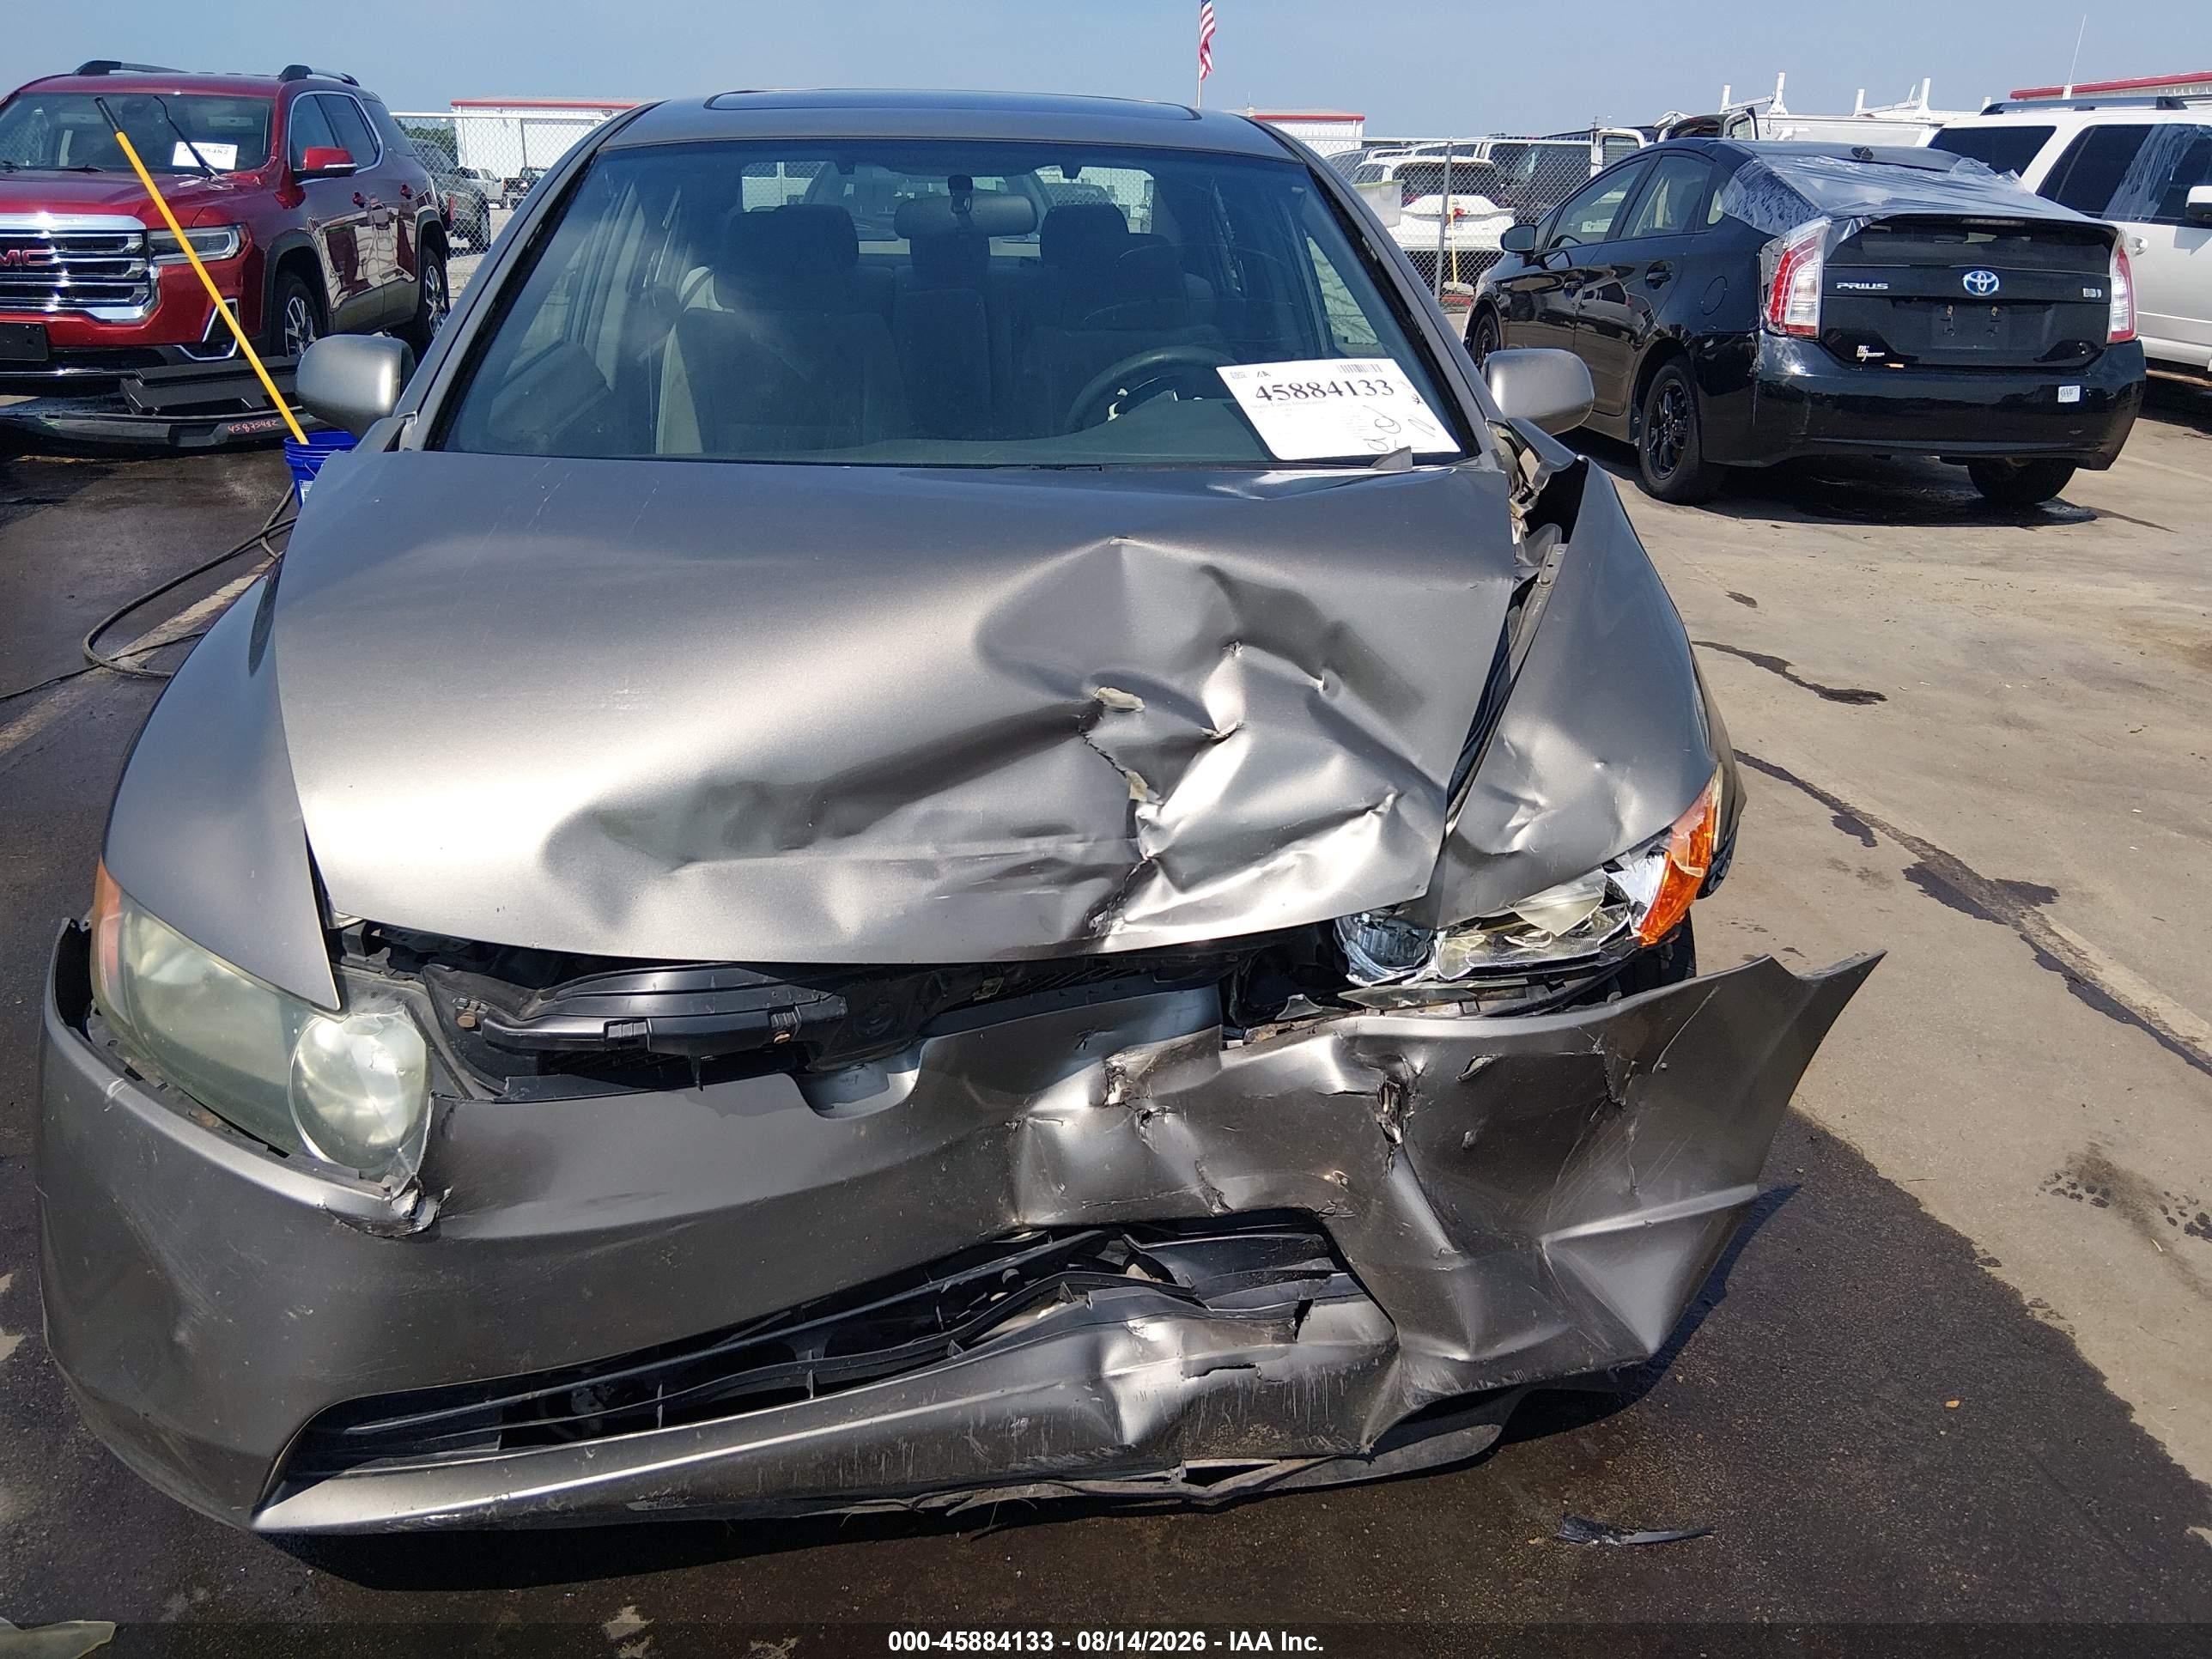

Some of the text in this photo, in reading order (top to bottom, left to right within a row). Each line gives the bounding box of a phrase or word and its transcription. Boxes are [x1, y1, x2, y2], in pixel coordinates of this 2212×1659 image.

[0, 249, 56, 267] MC
[1836, 282, 1889, 290] PRIUS
[1255, 379, 1395, 402] 45884133
